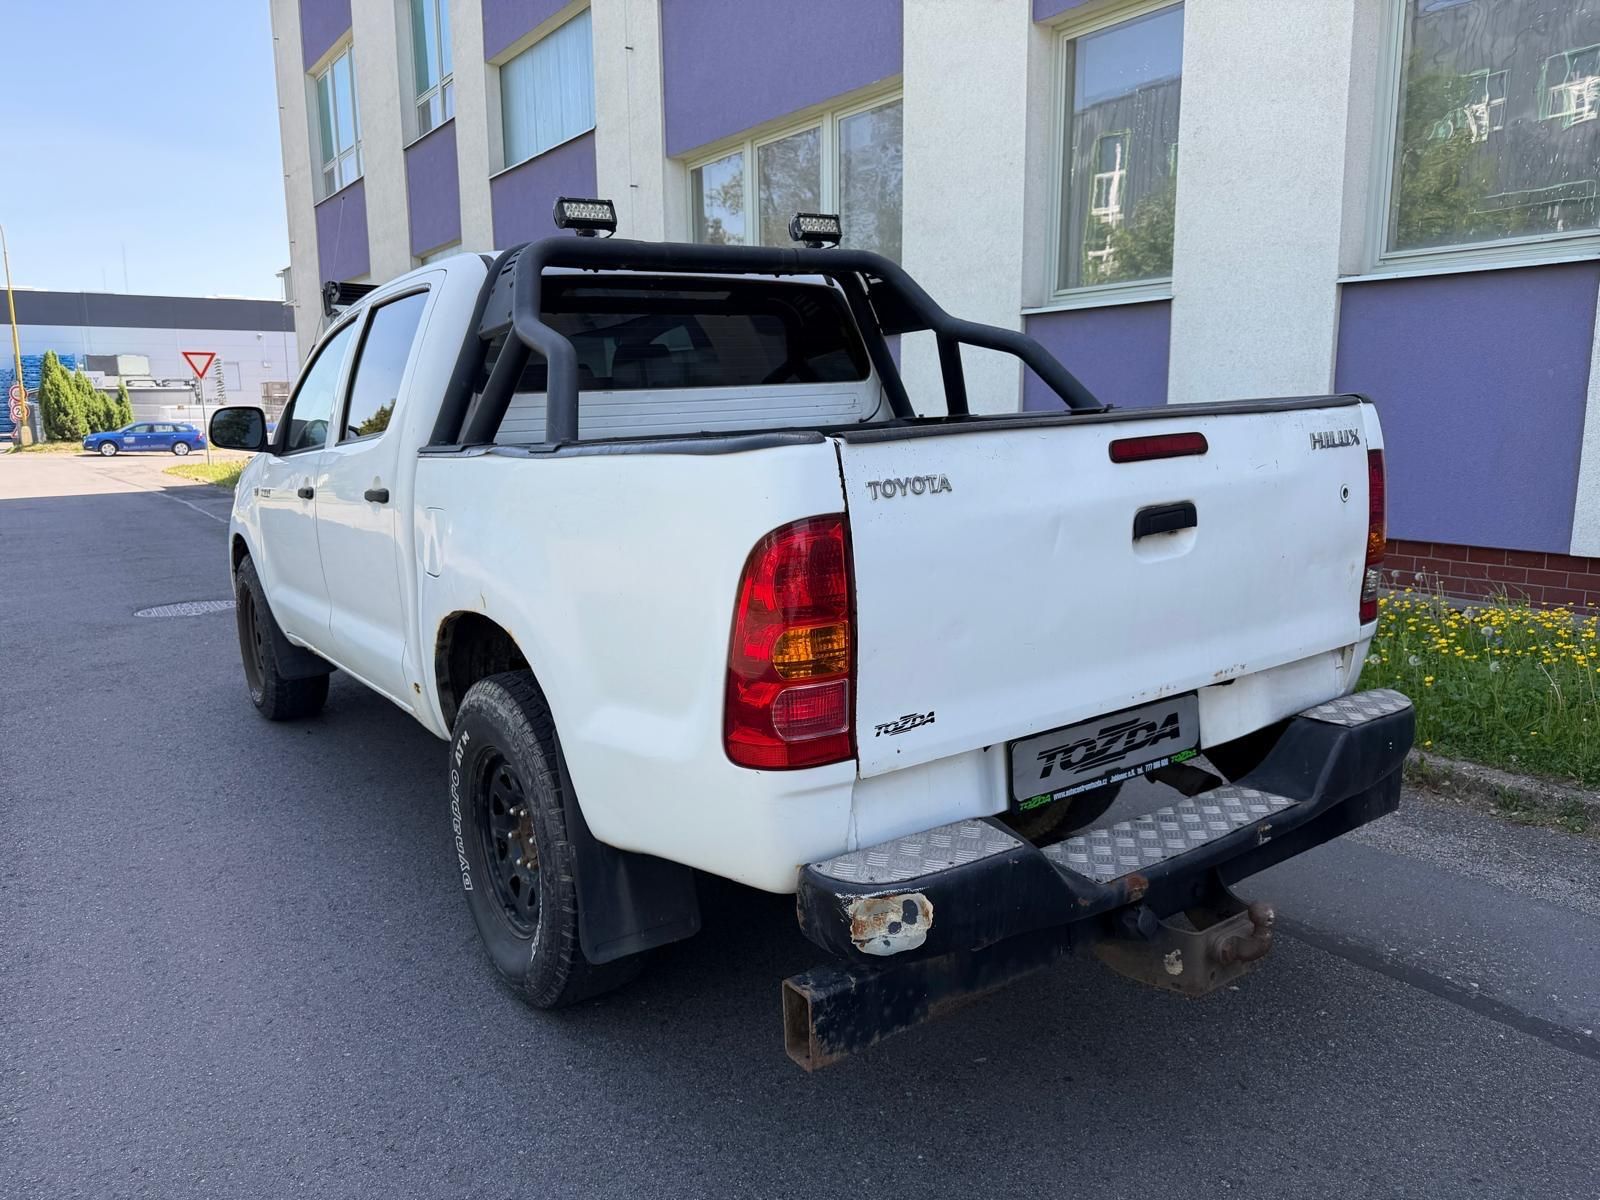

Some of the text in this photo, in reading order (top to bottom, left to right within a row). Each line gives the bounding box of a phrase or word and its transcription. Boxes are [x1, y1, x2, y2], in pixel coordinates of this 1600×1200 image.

[1310, 428, 1360, 450] HILUX
[866, 474, 952, 500] TOYOTA
[875, 711, 935, 737] TOZDA
[1037, 712, 1180, 779] TOZDA
[451, 769, 473, 890] Dynapro
